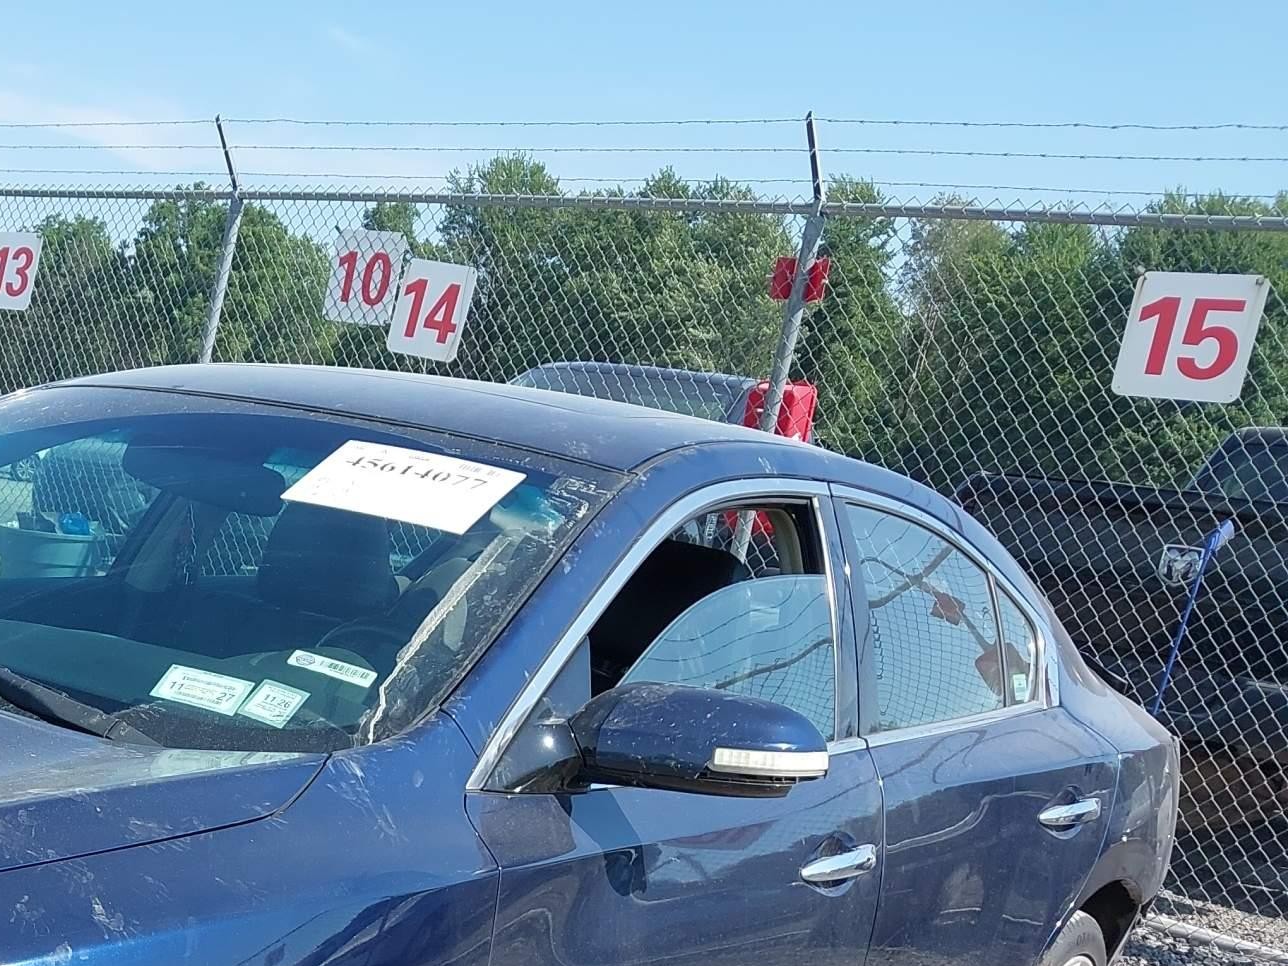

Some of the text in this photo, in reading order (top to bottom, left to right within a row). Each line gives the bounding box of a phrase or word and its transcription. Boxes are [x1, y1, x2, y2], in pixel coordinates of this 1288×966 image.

[338, 250, 392, 306] 10
[403, 278, 461, 344] 14
[1139, 296, 1246, 381] 15
